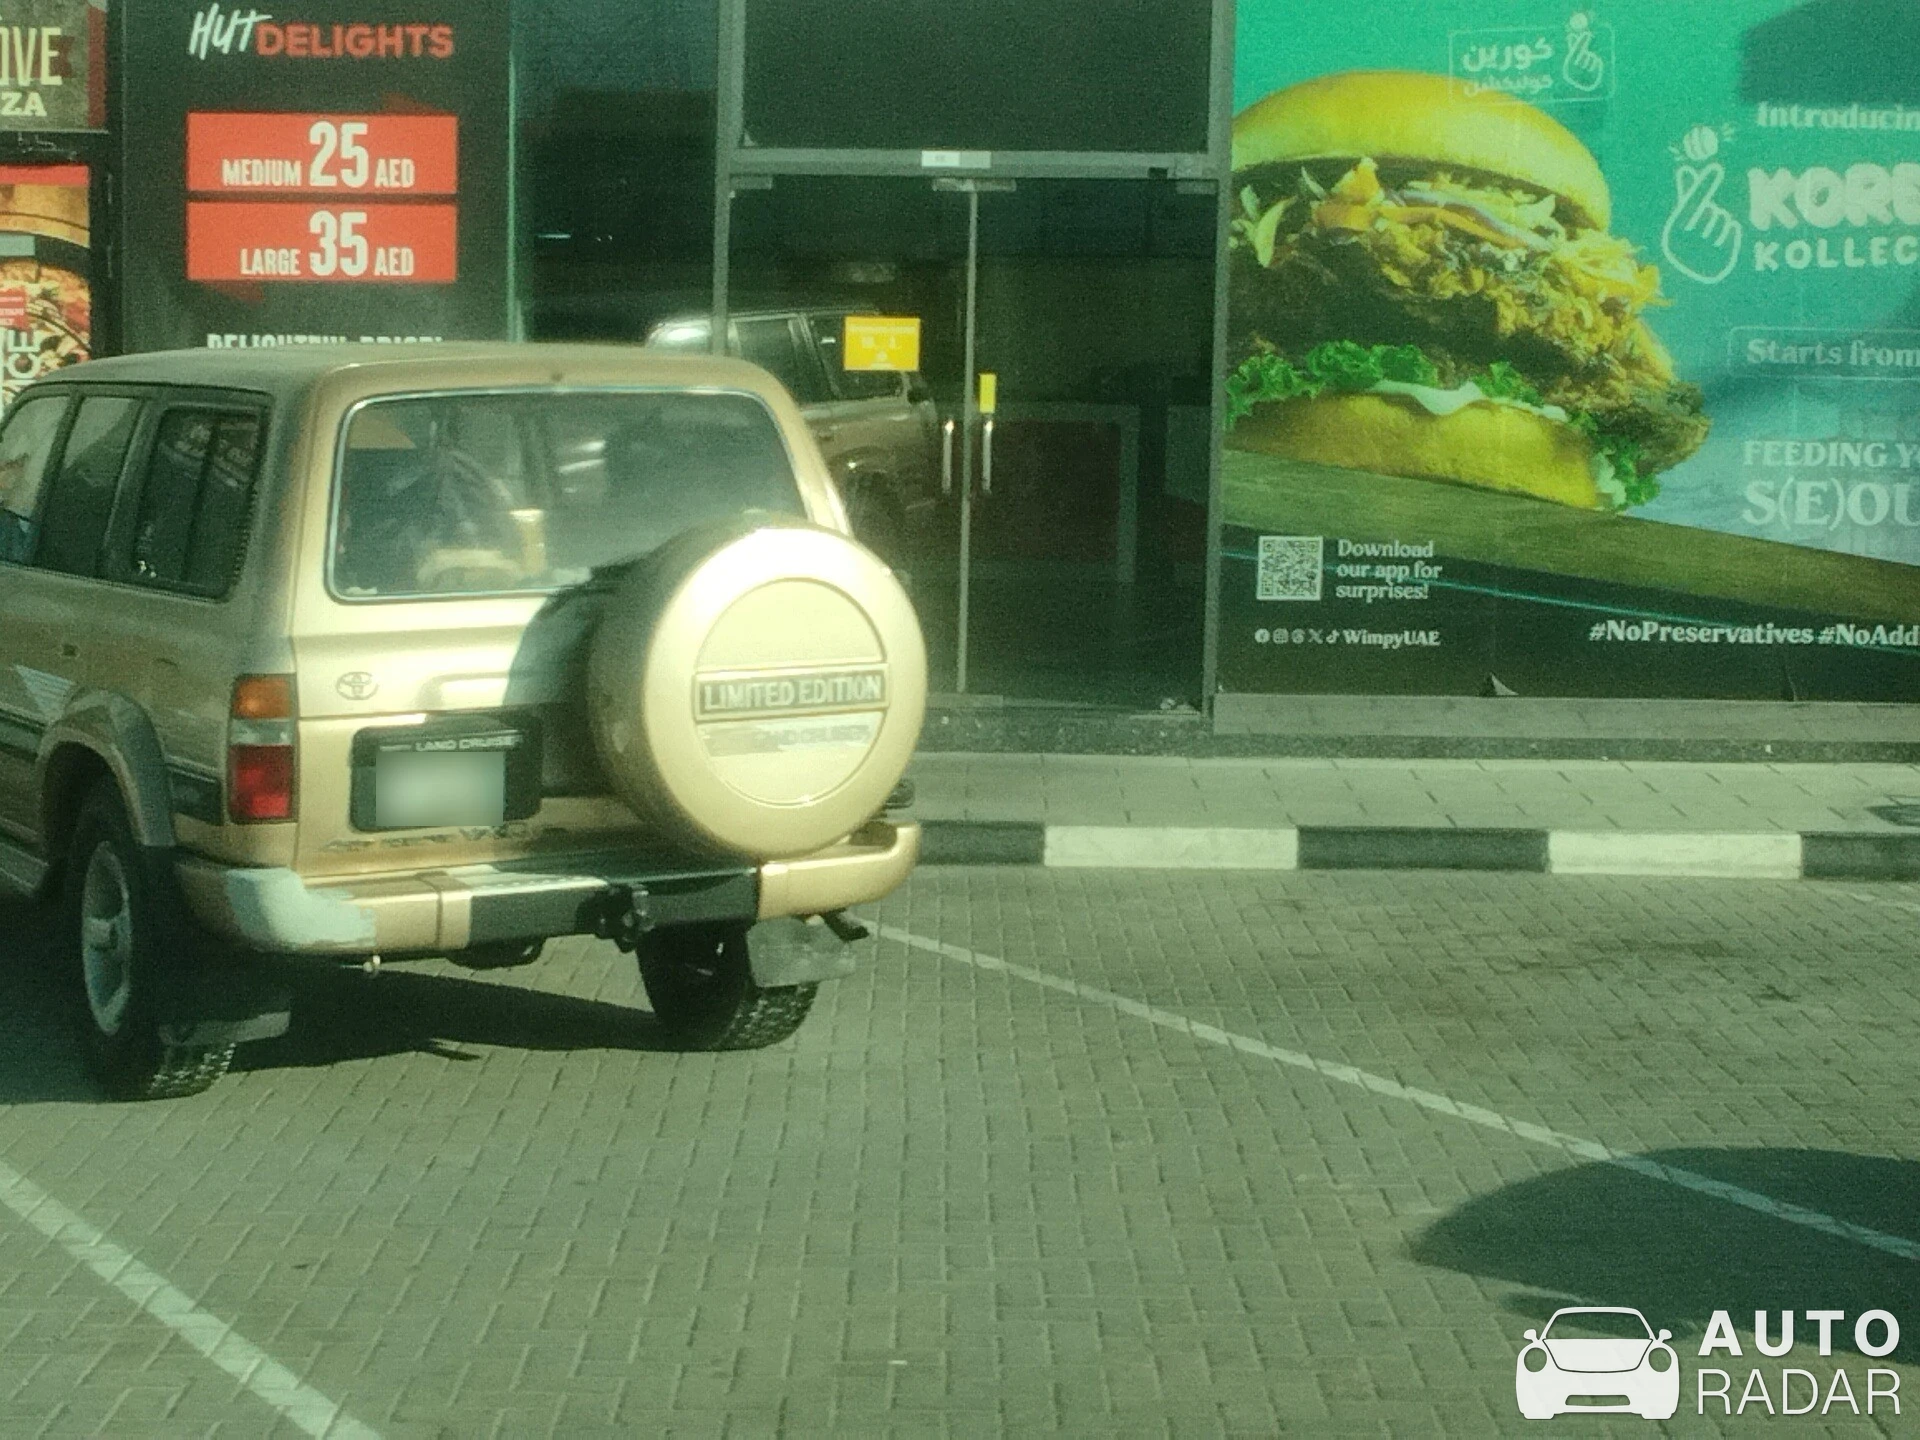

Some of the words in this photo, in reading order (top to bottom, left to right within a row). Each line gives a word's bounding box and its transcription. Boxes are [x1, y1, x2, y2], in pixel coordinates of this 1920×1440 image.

[256, 23, 454, 57] DELIGHTS
[1463, 37, 1552, 72] كورين
[222, 158, 302, 187] MEDIUM
[309, 121, 369, 187] 25
[374, 158, 415, 187] AED
[240, 248, 301, 275] LARGE
[309, 210, 368, 276] 35
[374, 247, 414, 276] AED
[1754, 236, 1918, 272] KOLLEC
[1747, 339, 1842, 365] Starts
[1850, 340, 1920, 368] from
[1743, 440, 1887, 468] FEEDING
[1894, 442, 1920, 469] Y
[1337, 539, 1434, 558] Download
[1337, 563, 1370, 578] our
[1376, 563, 1410, 582] app
[1414, 560, 1443, 579] for
[1335, 581, 1430, 603] surprises!
[1343, 629, 1441, 649] WimpyUAE
[1589, 619, 1814, 645] #NoPreservatives
[1818, 623, 1920, 646] #NoAdd
[704, 681, 796, 711] LIMITED
[798, 674, 882, 703] EDITION
